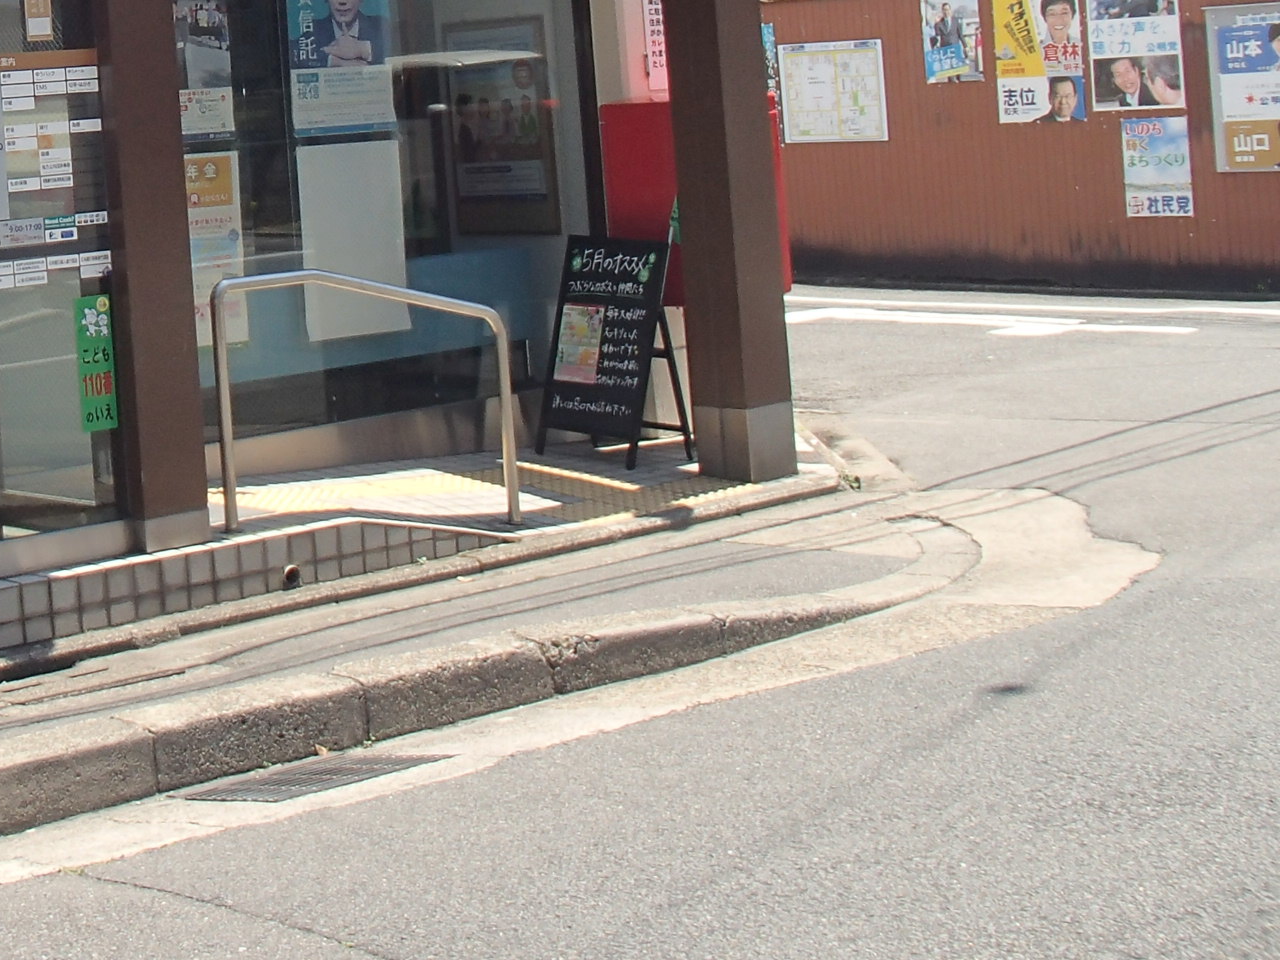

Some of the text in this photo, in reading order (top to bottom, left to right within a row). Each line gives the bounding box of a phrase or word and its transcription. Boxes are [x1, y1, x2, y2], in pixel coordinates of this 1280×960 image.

[1043, 43, 1081, 63] 倉林
[1226, 39, 1263, 59] 山本
[1003, 88, 1036, 107] 志位
[1126, 123, 1163, 136] いのち
[1233, 133, 1270, 152] 山口
[186, 162, 217, 179] 年金
[1147, 196, 1191, 214] 社民党
[582, 248, 648, 275] 5月のオススメ
[82, 346, 110, 364] こども
[86, 403, 114, 423] のいえ
